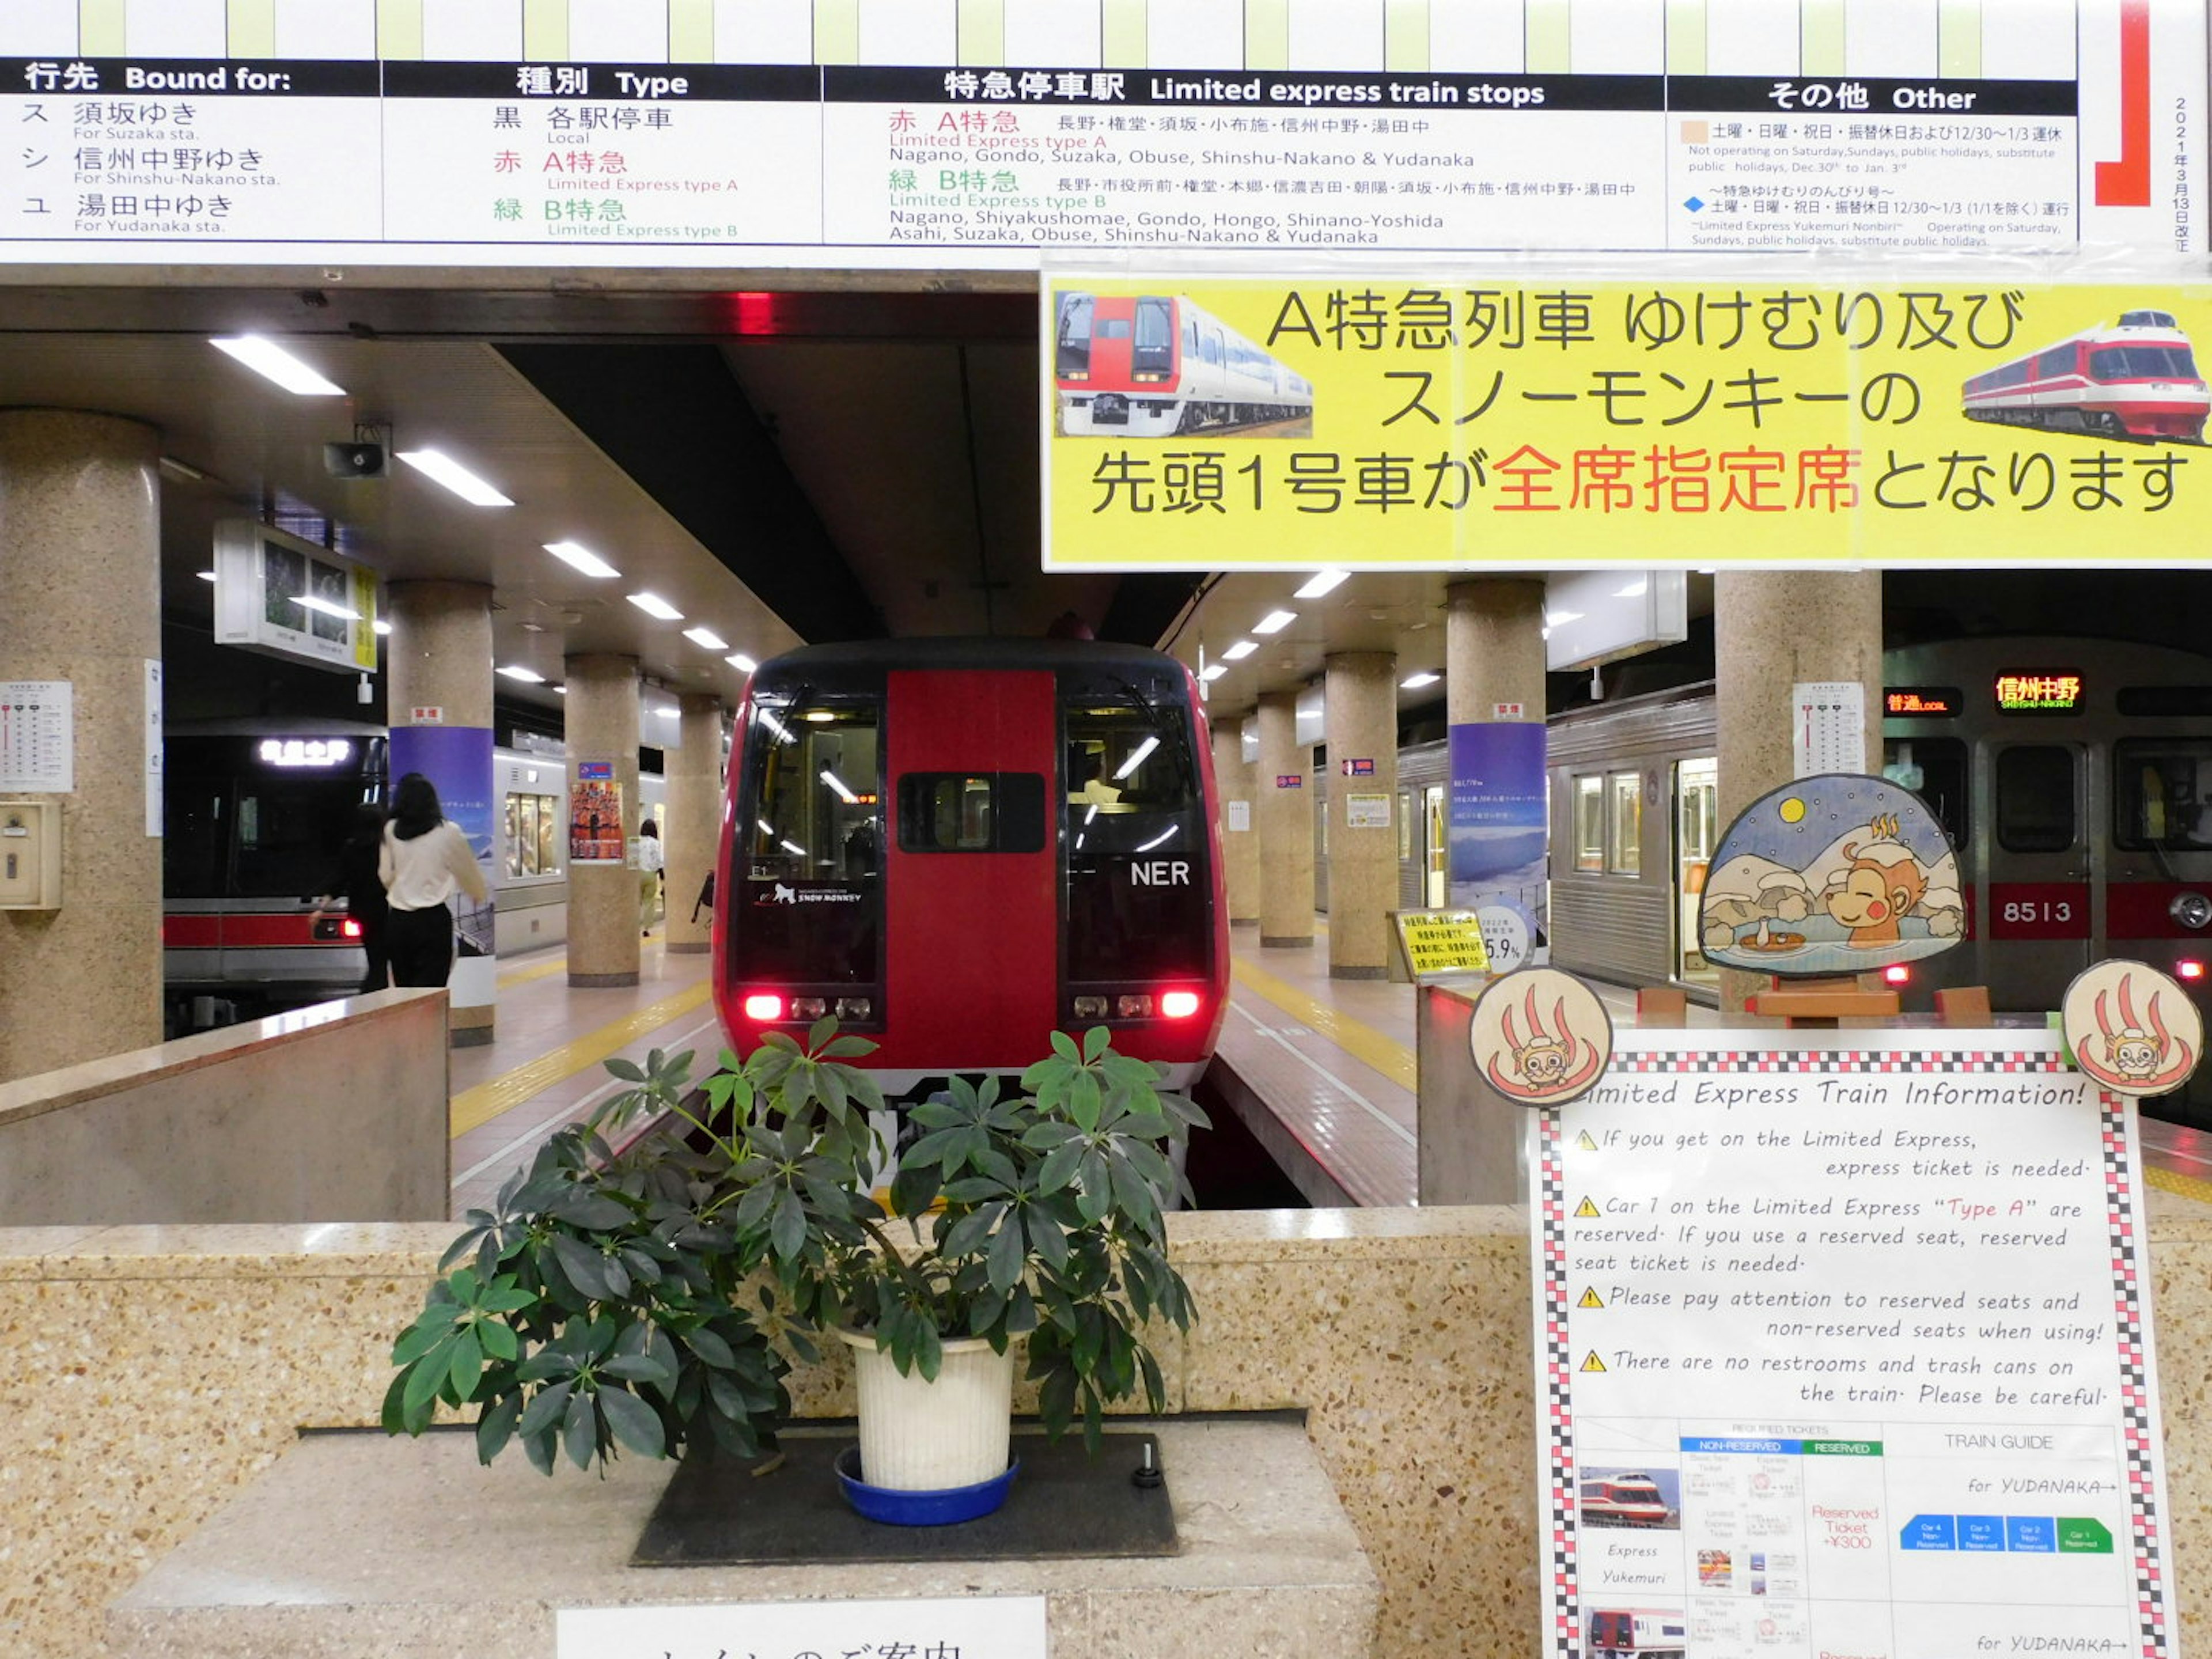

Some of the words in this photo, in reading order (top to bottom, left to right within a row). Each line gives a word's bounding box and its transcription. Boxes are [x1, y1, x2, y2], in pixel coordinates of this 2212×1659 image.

[22, 60, 100, 93] 行先
[124, 66, 226, 90] Bound
[233, 67, 290, 91] for:
[514, 65, 590, 97] 種別
[613, 73, 688, 99] Type
[942, 70, 1127, 101] 特急停車駅
[1150, 78, 1262, 100] Limited
[1268, 84, 1382, 104] express
[1389, 81, 1458, 102] train
[1468, 84, 1544, 107] stops
[1769, 80, 1871, 111] その他
[1891, 86, 1978, 111] Other
[22, 104, 48, 122] ス
[75, 103, 195, 124] 須坂ゆき
[494, 107, 521, 128] 黒
[548, 106, 672, 130] 各駅停車
[889, 109, 915, 132] 赤
[938, 111, 1020, 132] A特急
[1058, 115, 1429, 134] 長野・権堂・須坂・小布施・信州中野・湯田中
[74, 127, 100, 138] For
[107, 127, 164, 139] Suzaka
[171, 130, 198, 140] sta.
[548, 132, 589, 143] Local
[891, 134, 960, 150] Limited
[968, 132, 1039, 150] Express
[1046, 136, 1086, 150] type
[1094, 136, 1106, 150] A
[2033, 127, 2061, 141] 運休
[22, 148, 48, 168] シ
[74, 147, 262, 171] 信州中野ゆき
[494, 150, 521, 172] 赤
[543, 151, 627, 173] A特急
[891, 148, 968, 164] Nagano,
[975, 148, 1044, 164] Gondo,
[1052, 148, 1121, 165] Suzaka,
[1130, 150, 1194, 166] Obuse,
[1202, 151, 1355, 165] Shinshu-Nakano
[1363, 152, 1376, 165] &
[1384, 153, 1474, 166] Yudanaka
[75, 172, 101, 184] For
[107, 171, 246, 184] Shinshu-Nakano
[252, 175, 279, 184] sta.
[888, 171, 917, 192] 緑
[940, 169, 1019, 192] B特急
[1057, 178, 1635, 195] 長野・市役所前・権堂・本郷・信濃吉田・朝陽・須坂・小布施・信州中野・湯田中
[23, 198, 51, 213] ユ
[78, 194, 232, 217] 湯田中ゆき
[493, 199, 522, 222] 緑
[545, 199, 626, 221] B特急
[2043, 203, 2069, 215] 運行
[75, 220, 101, 231] For
[107, 220, 190, 232] Yudanaka
[196, 222, 224, 232] sta.
[891, 210, 968, 228] Nagano,
[976, 210, 1130, 229] Shiyakushomae,
[1138, 212, 1206, 228] Gondo,
[1215, 213, 1280, 229] Hongo,
[1288, 213, 1442, 228] Shinano-Yoshida
[1264, 288, 1596, 352] A特急列車
[1626, 288, 2027, 352] ゆけむり及び
[1382, 367, 1922, 429] スノーモンキーの
[1092, 442, 2191, 515] 先頭1号車が全席指定席となります
[1996, 677, 2079, 701] 信州中野
[1887, 694, 1920, 711] 普通
[1131, 862, 1190, 886] NER
[2003, 902, 2071, 922] 8513
[1571, 1081, 1678, 1104] imited
[1695, 1082, 1798, 1109] Express
[1817, 1080, 1887, 1104] Train
[1906, 1079, 2088, 1105] Information!
[1604, 1130, 1621, 1146] If
[1630, 1135, 1663, 1149] you
[1676, 1132, 1708, 1149] get
[1721, 1135, 1744, 1146] on
[1757, 1130, 1790, 1146] the
[1804, 1129, 1882, 1146] Limited
[1895, 1131, 1975, 1152] Express,
[1827, 1164, 1900, 1179] express
[1912, 1159, 1972, 1175] ticket
[1986, 1161, 1999, 1176] is
[1607, 1198, 1639, 1213] Car
[1671, 1202, 1693, 1214] on
[1706, 1197, 1740, 1214] the
[1753, 1197, 1832, 1214] Limited
[1844, 1198, 1920, 1220] Express
[2050, 1206, 2081, 1217] are
[1679, 1226, 1696, 1243] If
[1705, 1231, 1740, 1246] you
[1753, 1232, 1784, 1243] use
[1797, 1232, 1806, 1243] a
[1820, 1226, 1904, 1244] reserved
[1917, 1230, 1964, 1247] seat,
[1981, 1228, 2066, 1246] reserved
[1575, 1255, 1616, 1270] seat
[1630, 1254, 1688, 1271] ticket
[1702, 1256, 1715, 1271] is
[1610, 1286, 1671, 1305] Please
[1683, 1294, 1718, 1310] pay
[1731, 1291, 1831, 1307] attention
[1844, 1292, 1866, 1308] to
[1880, 1290, 1965, 1309] reserved
[1978, 1294, 2030, 1309] seats
[2043, 1292, 2079, 1310] and
[1767, 1321, 1900, 1336] non-reserved
[1914, 1323, 1965, 1338] seats
[1979, 1321, 2031, 1339] when
[2044, 1323, 2103, 1344] using!
[1613, 1350, 1669, 1369] There
[1682, 1358, 1713, 1369] are
[1725, 1358, 1749, 1370] no
[1762, 1356, 1866, 1372] restrooms
[1878, 1355, 1915, 1373] and
[1929, 1357, 1980, 1373] trash
[1994, 1362, 2036, 1374] cans
[2049, 1363, 2073, 1375] on
[1801, 1383, 1834, 1401] the
[1919, 1384, 1981, 1403] Please
[1995, 1386, 2017, 1404] be
[1699, 1441, 1781, 1451] NON-RESERVED
[1815, 1442, 1870, 1453] RESERVED
[1945, 1434, 1995, 1447] TRAIN
[2002, 1435, 2052, 1449] GUIDE
[1968, 1479, 1991, 1493] for
[2002, 1479, 2100, 1494] YUDANAKA
[1813, 1506, 1878, 1522] Reserved
[1825, 1521, 1866, 1533] Ticket
[1608, 1544, 1657, 1558] Express
[1604, 1570, 1666, 1584] Yukemuri
[1978, 1637, 2001, 1651] for
[2011, 1637, 2112, 1652] YUDANAKA
